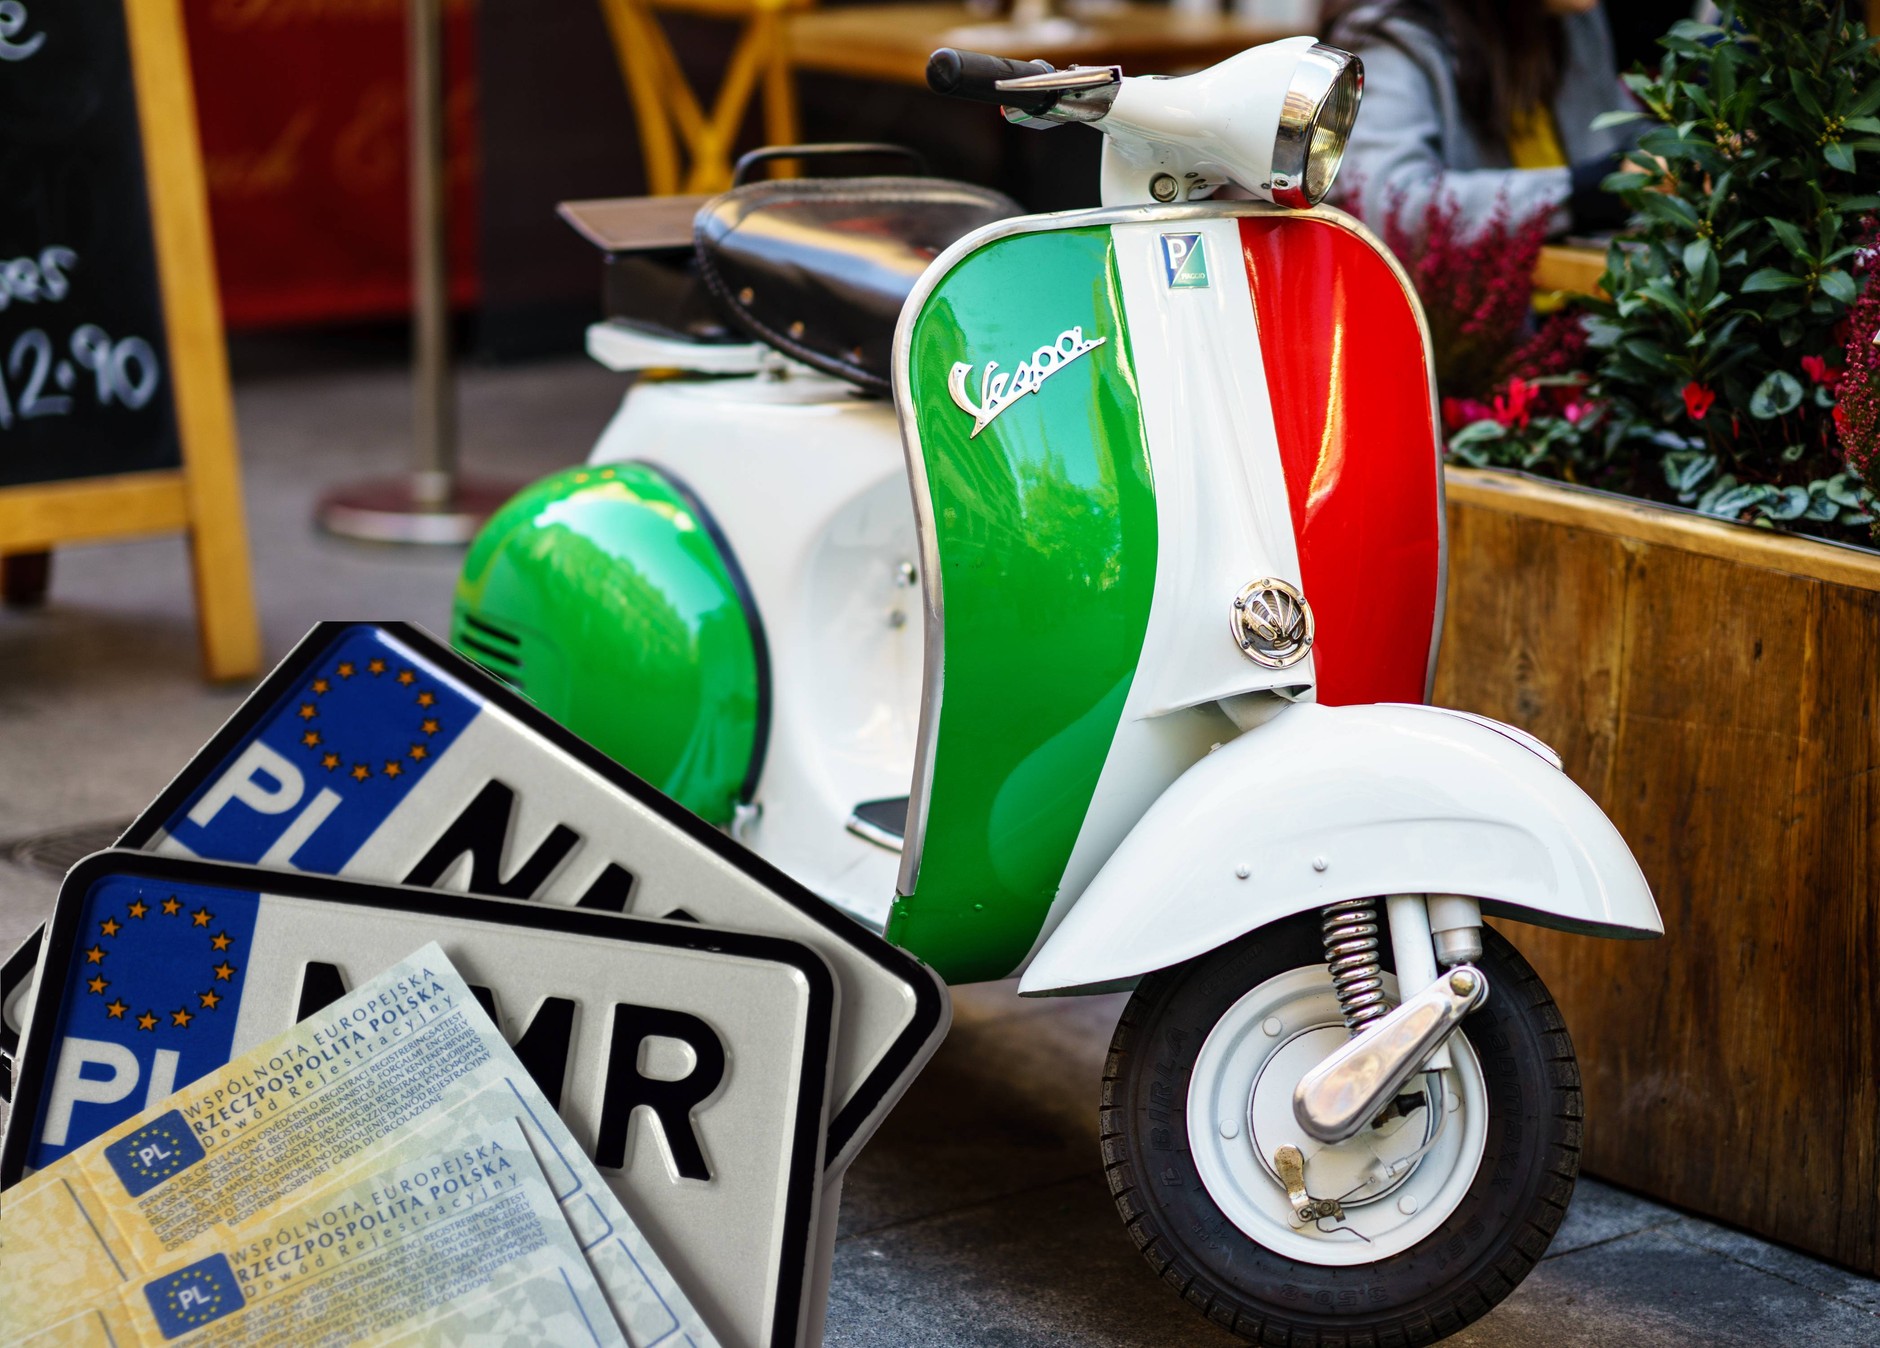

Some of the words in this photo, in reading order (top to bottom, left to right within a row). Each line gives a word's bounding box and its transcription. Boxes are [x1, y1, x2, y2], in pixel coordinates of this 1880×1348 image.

[1167, 238, 1188, 269] P
[948, 325, 1107, 440] Vespa
[183, 1041, 309, 1121] WSPÓLNOTA
[313, 964, 436, 1045] EUROPEJSKA
[192, 1027, 365, 1136] RZECZPOSPOLITA
[368, 978, 445, 1032] POLSKA
[200, 1097, 278, 1149] Dowód
[287, 993, 455, 1099] Rejestracyjny
[376, 1047, 423, 1080] FORGALMI
[137, 1180, 179, 1210] PERMISO
[178, 1172, 193, 1185] DE
[192, 1135, 257, 1177] CIRCULACIÓN
[308, 1099, 319, 1110] O
[318, 1069, 369, 1104] REGISTRACI
[368, 1011, 463, 1073] REGISTRERINGSATTEST
[139, 1144, 171, 1167] PL
[148, 1185, 212, 1227] REGISTRATION
[212, 1153, 266, 1189] CERTIFICATE
[264, 1125, 314, 1158] CERTIFICAT
[404, 1026, 475, 1074] KENTEKENBEWIJS
[153, 1196, 212, 1235] CERTIFICADO
[210, 1189, 225, 1201] DE
[374, 1062, 436, 1104] REGISTRACIJOS
[222, 1206, 234, 1217] O
[233, 1179, 280, 1211] EVIDENCII
[278, 1148, 332, 1184] PROMETNO
[331, 1115, 388, 1153] DOVOLJENJE
[387, 1091, 427, 1120] DOWÓD
[426, 1050, 492, 1096] REJESTRACYJNY
[226, 1161, 331, 1226] REGISTRERINGSBEVISET
[330, 1142, 362, 1165] CARTA
[362, 1135, 375, 1147] DI
[374, 1092, 443, 1139] CIRCOLAZIONE
[229, 1199, 364, 1266] WSPÓLNOTA
[371, 1138, 504, 1206] EUROPEJSKA
[235, 1192, 424, 1284] RZECZPOSPOLITA
[429, 1154, 511, 1200] POLSKA
[243, 1253, 325, 1298] Dowód
[338, 1170, 519, 1259] Rejestracyjny
[355, 1261, 366, 1271] O
[430, 1223, 481, 1250] FORGALMI
[178, 1286, 211, 1311] PL
